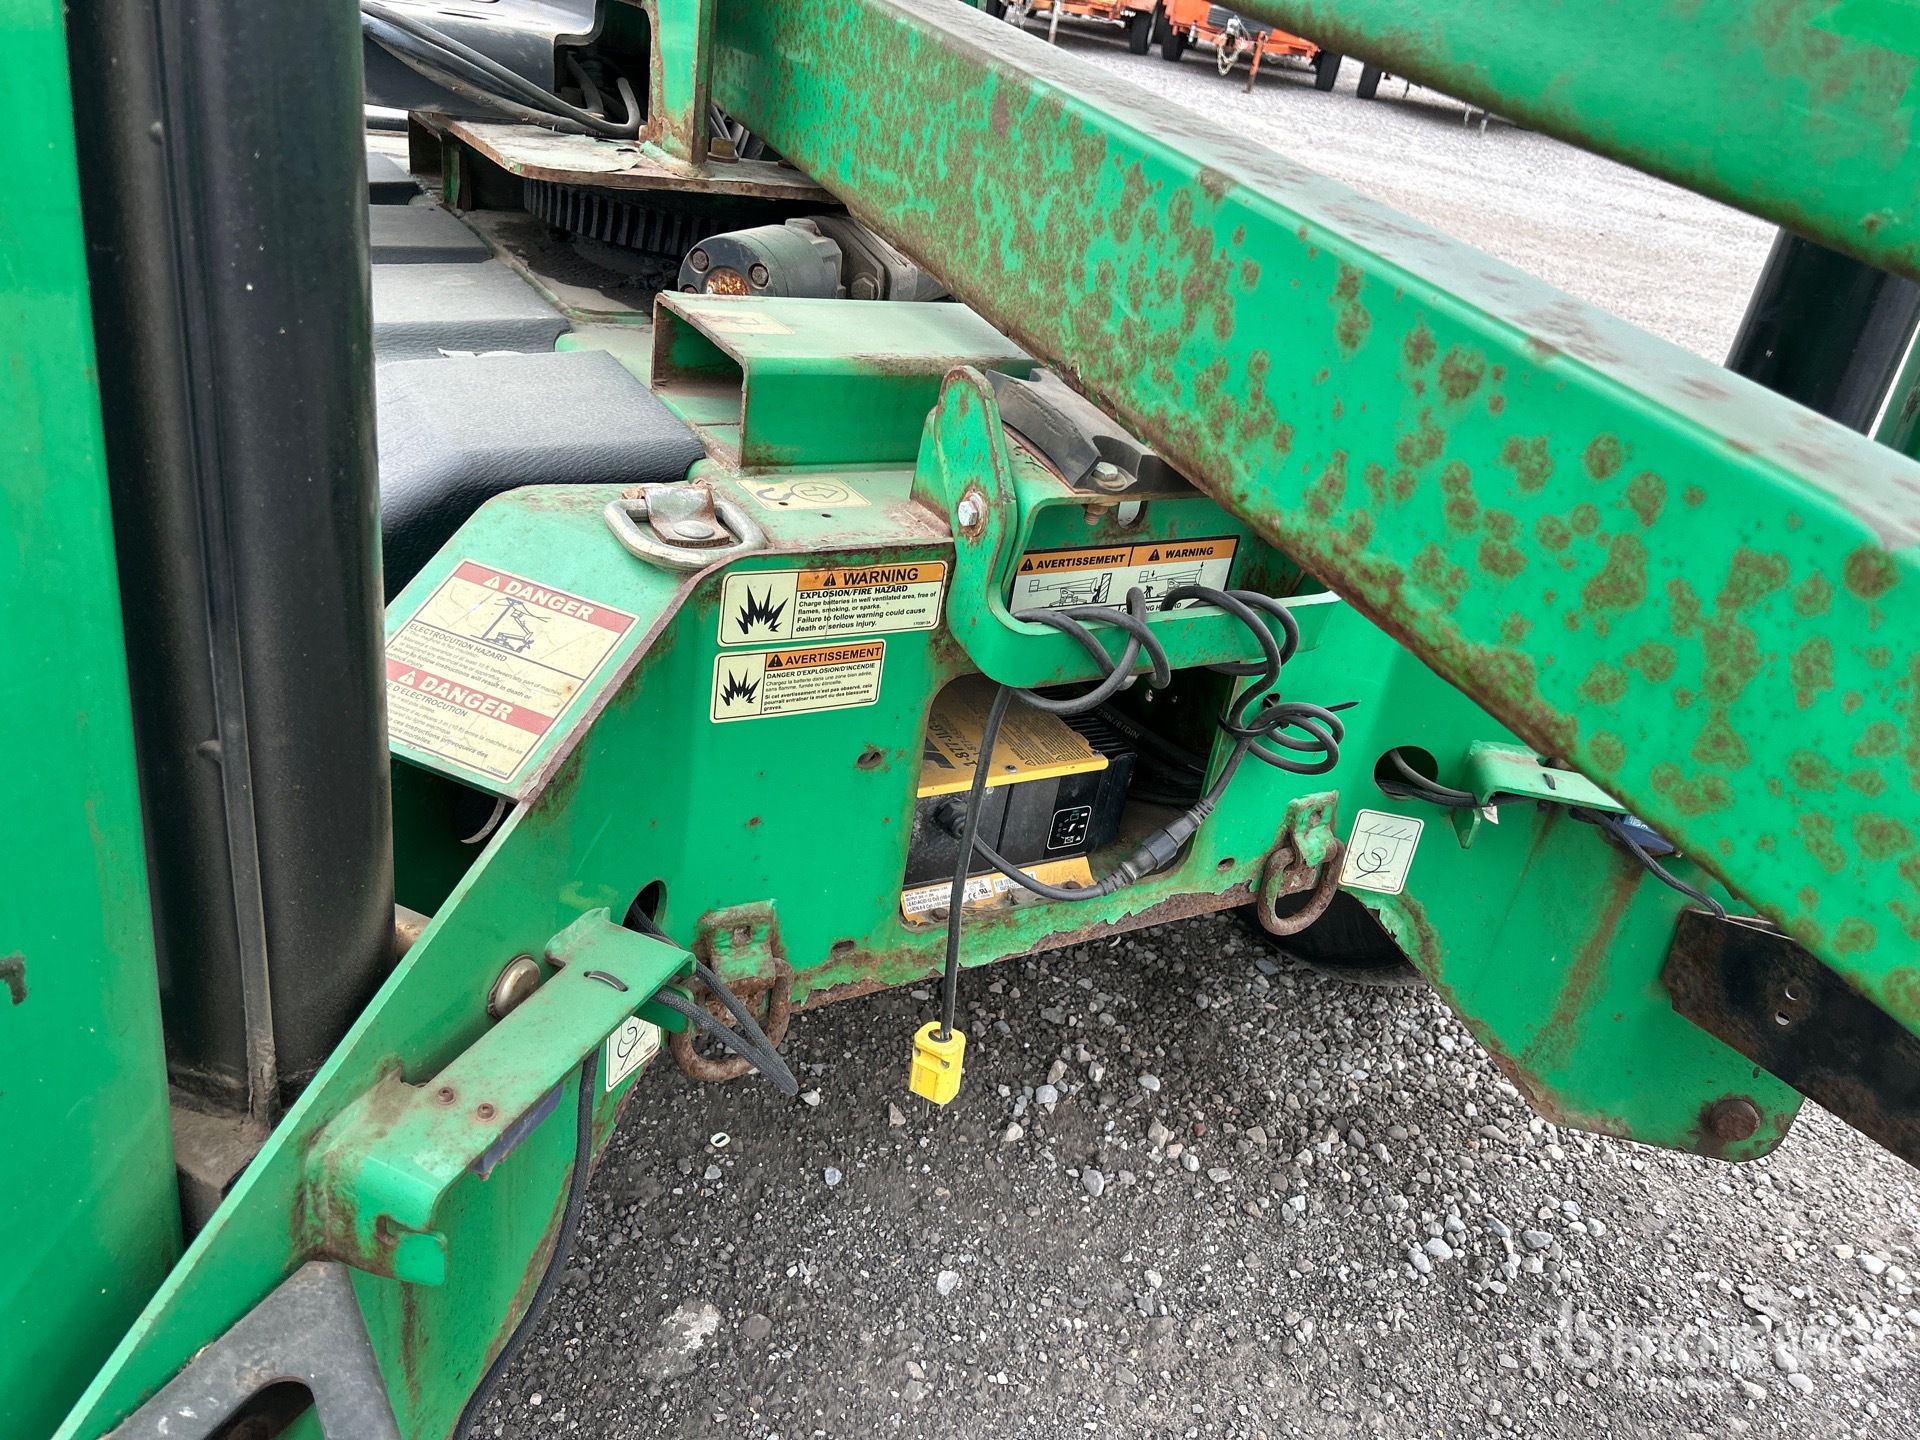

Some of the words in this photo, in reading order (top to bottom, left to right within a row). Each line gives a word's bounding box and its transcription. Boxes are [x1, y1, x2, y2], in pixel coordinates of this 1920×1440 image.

[1165, 547, 1214, 559] WARNING
[1036, 554, 1125, 569] AVERTISSEMENT
[842, 567, 919, 585] WARNING
[800, 587, 872, 599] EXPLOSION/FIRE
[874, 585, 908, 594] HAZARD
[871, 594, 901, 602] ventilated
[502, 580, 597, 620] DANGER
[797, 615, 822, 623] Failure
[833, 613, 854, 621] follow
[856, 611, 883, 619] warning
[885, 609, 904, 617] could
[828, 622, 854, 630] serious
[408, 623, 475, 650] ELECTROCUTION
[473, 646, 508, 662] HAZARD
[785, 647, 881, 665] AVERTISSEMENT
[389, 645, 410, 655] Failure
[416, 655, 436, 665] follow
[434, 661, 471, 677] instructions
[481, 678, 500, 688] result
[506, 686, 525, 697] death
[766, 671, 795, 679] DANGER
[417, 676, 516, 721] DANGER
[781, 689, 816, 697] avertissement
[402, 730, 434, 745] mortelles.
[403, 723, 441, 740] instructions
[440, 736, 477, 753] provoquera
[476, 749, 490, 758] des
